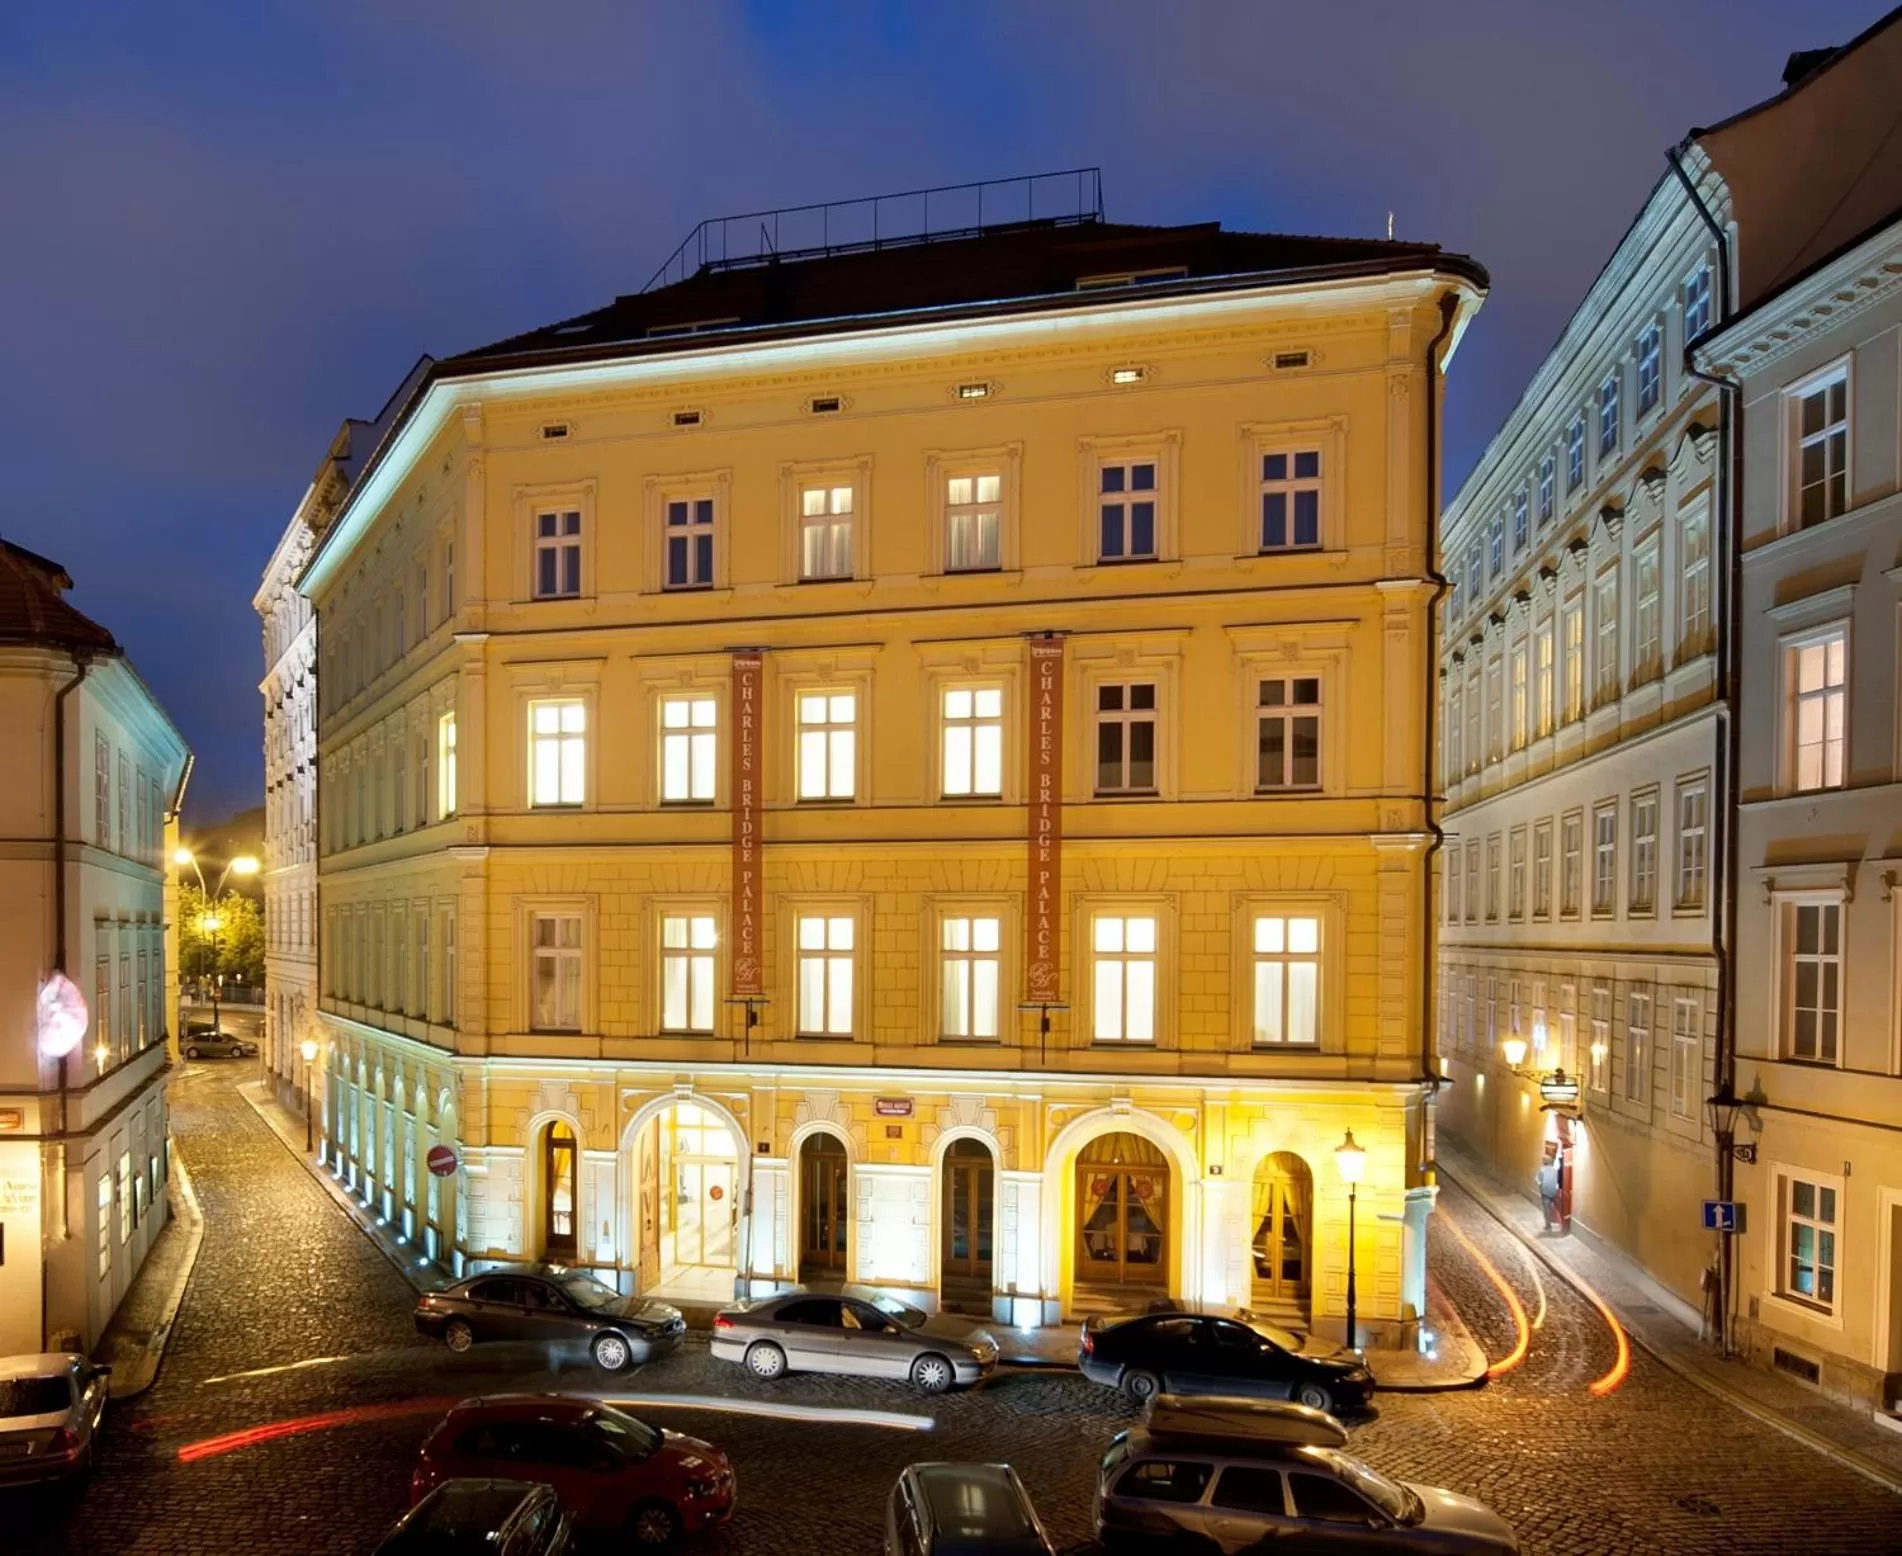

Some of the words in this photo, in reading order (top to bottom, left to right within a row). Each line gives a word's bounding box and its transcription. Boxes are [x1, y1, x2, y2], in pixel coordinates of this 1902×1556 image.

[741, 673, 753, 771] CHARLES
[1040, 661, 1053, 766] CHARLES
[742, 779, 753, 863] BRIDGE
[1039, 774, 1052, 862] BRIDGE
[742, 870, 753, 954] PALACE
[1038, 871, 1050, 959] PALACE
